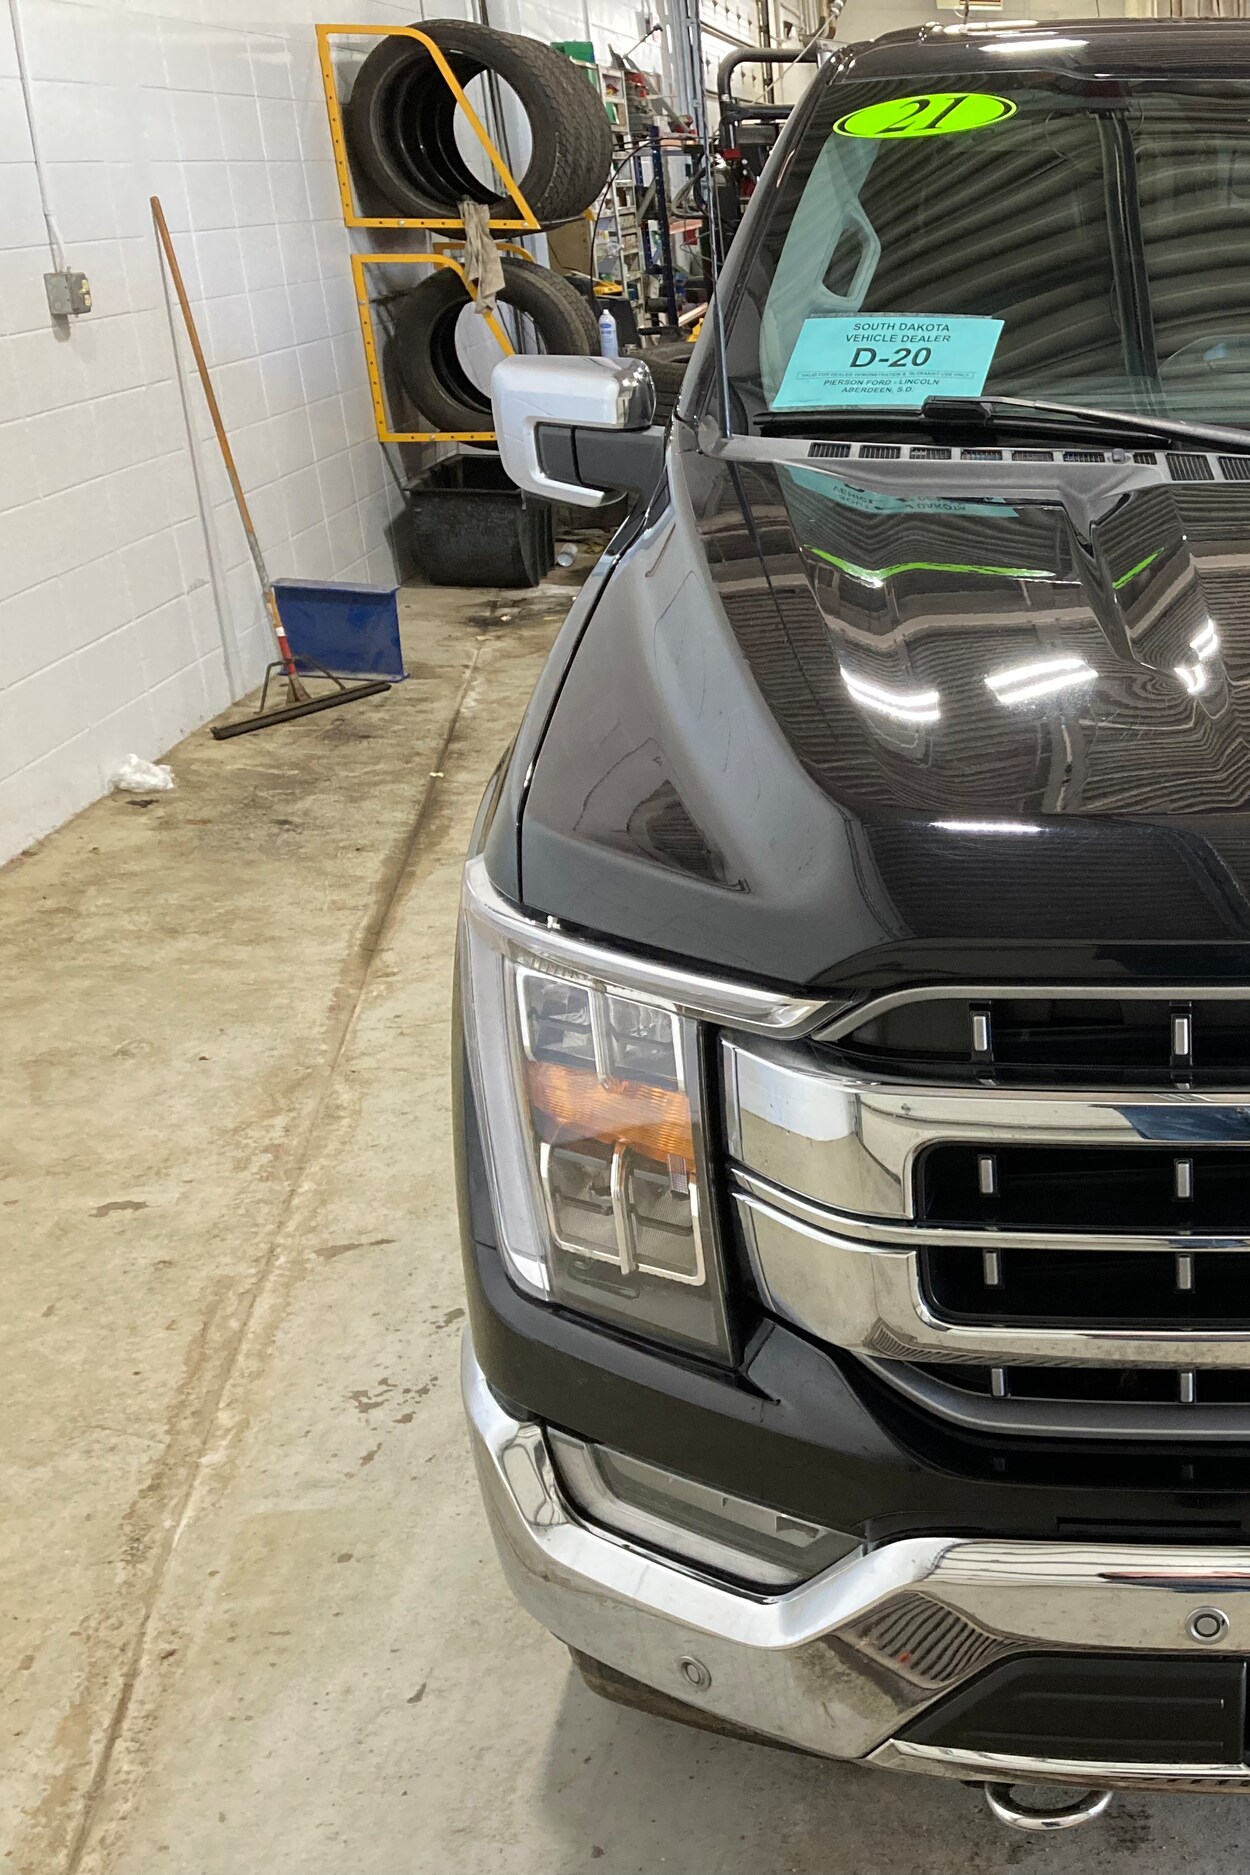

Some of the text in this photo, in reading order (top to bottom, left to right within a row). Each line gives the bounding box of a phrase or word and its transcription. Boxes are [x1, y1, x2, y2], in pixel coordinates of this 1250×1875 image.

[874, 95, 970, 135] 21
[853, 322, 950, 332] SOUTH DAKOTA
[846, 334, 951, 343] VEHICLE DEALER
[850, 347, 932, 368] D-20
